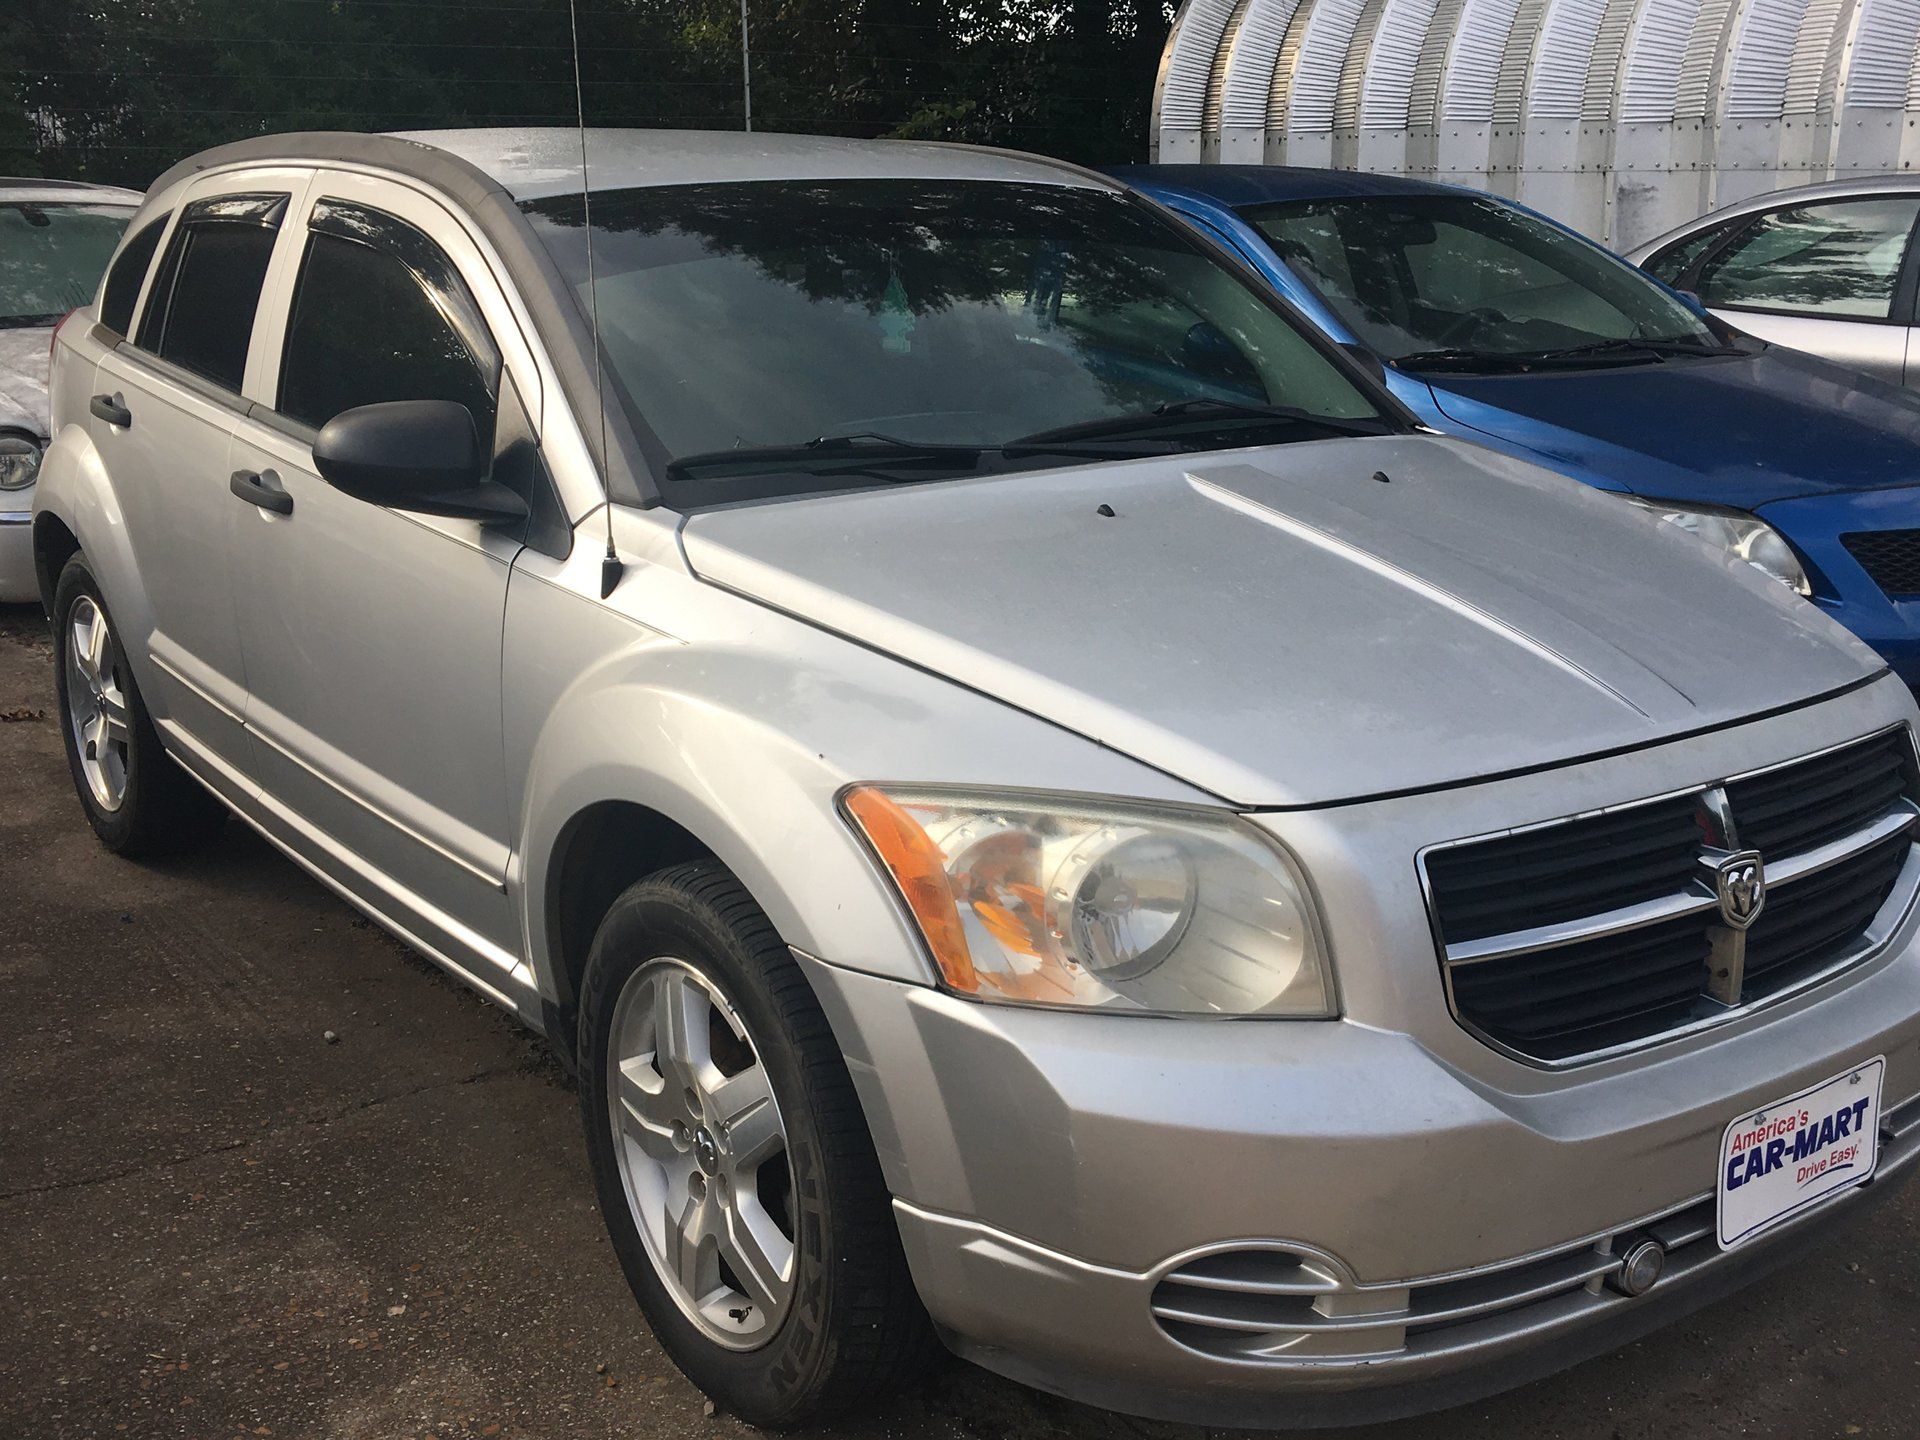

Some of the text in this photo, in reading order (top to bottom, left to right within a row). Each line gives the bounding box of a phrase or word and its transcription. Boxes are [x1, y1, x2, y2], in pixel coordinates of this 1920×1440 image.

[1726, 1096, 1869, 1192] CAR-MART
[1731, 1109, 1809, 1155] America's
[1796, 1158, 1827, 1183] Drive
[769, 1140, 823, 1396] NEXEN
